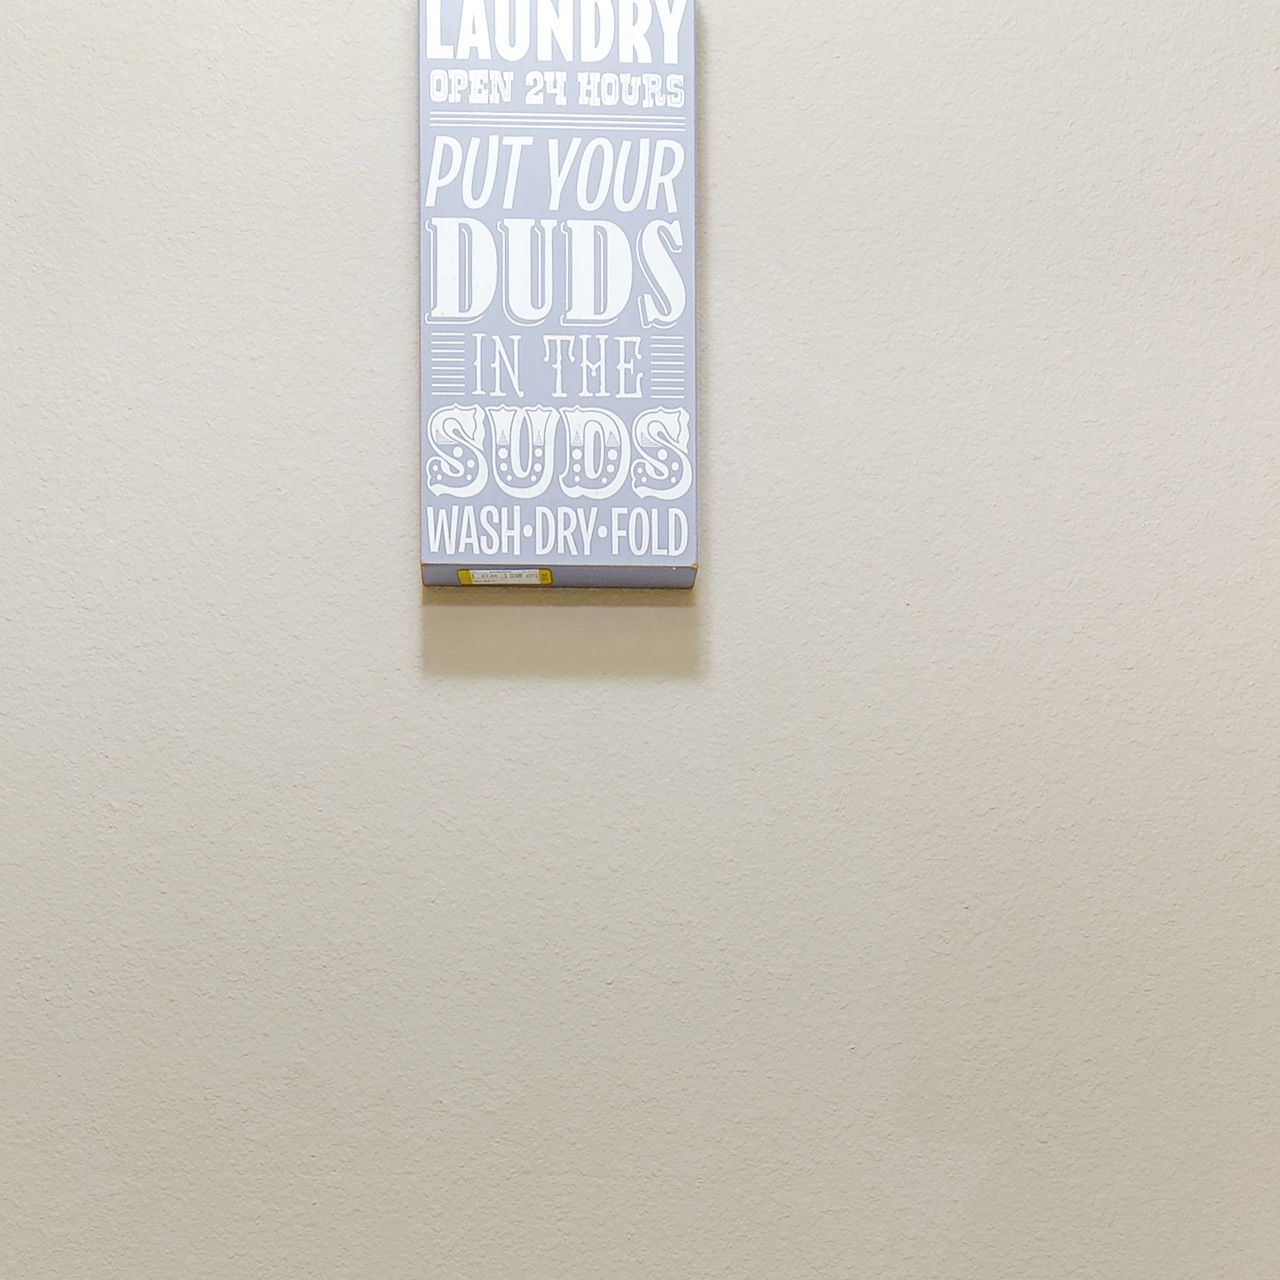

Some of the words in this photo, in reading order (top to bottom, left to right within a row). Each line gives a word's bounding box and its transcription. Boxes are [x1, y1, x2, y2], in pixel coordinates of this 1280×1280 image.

[426, 0, 687, 64] LAUNDRY
[429, 69, 514, 103] OPEN
[525, 71, 567, 105] 24
[577, 72, 685, 108] HOURS
[425, 135, 534, 209] PUT
[548, 137, 685, 213] YOUR
[425, 217, 686, 328] DUDS
[472, 333, 524, 397] IN
[543, 335, 643, 398] THE
[426, 403, 693, 500] SUDS
